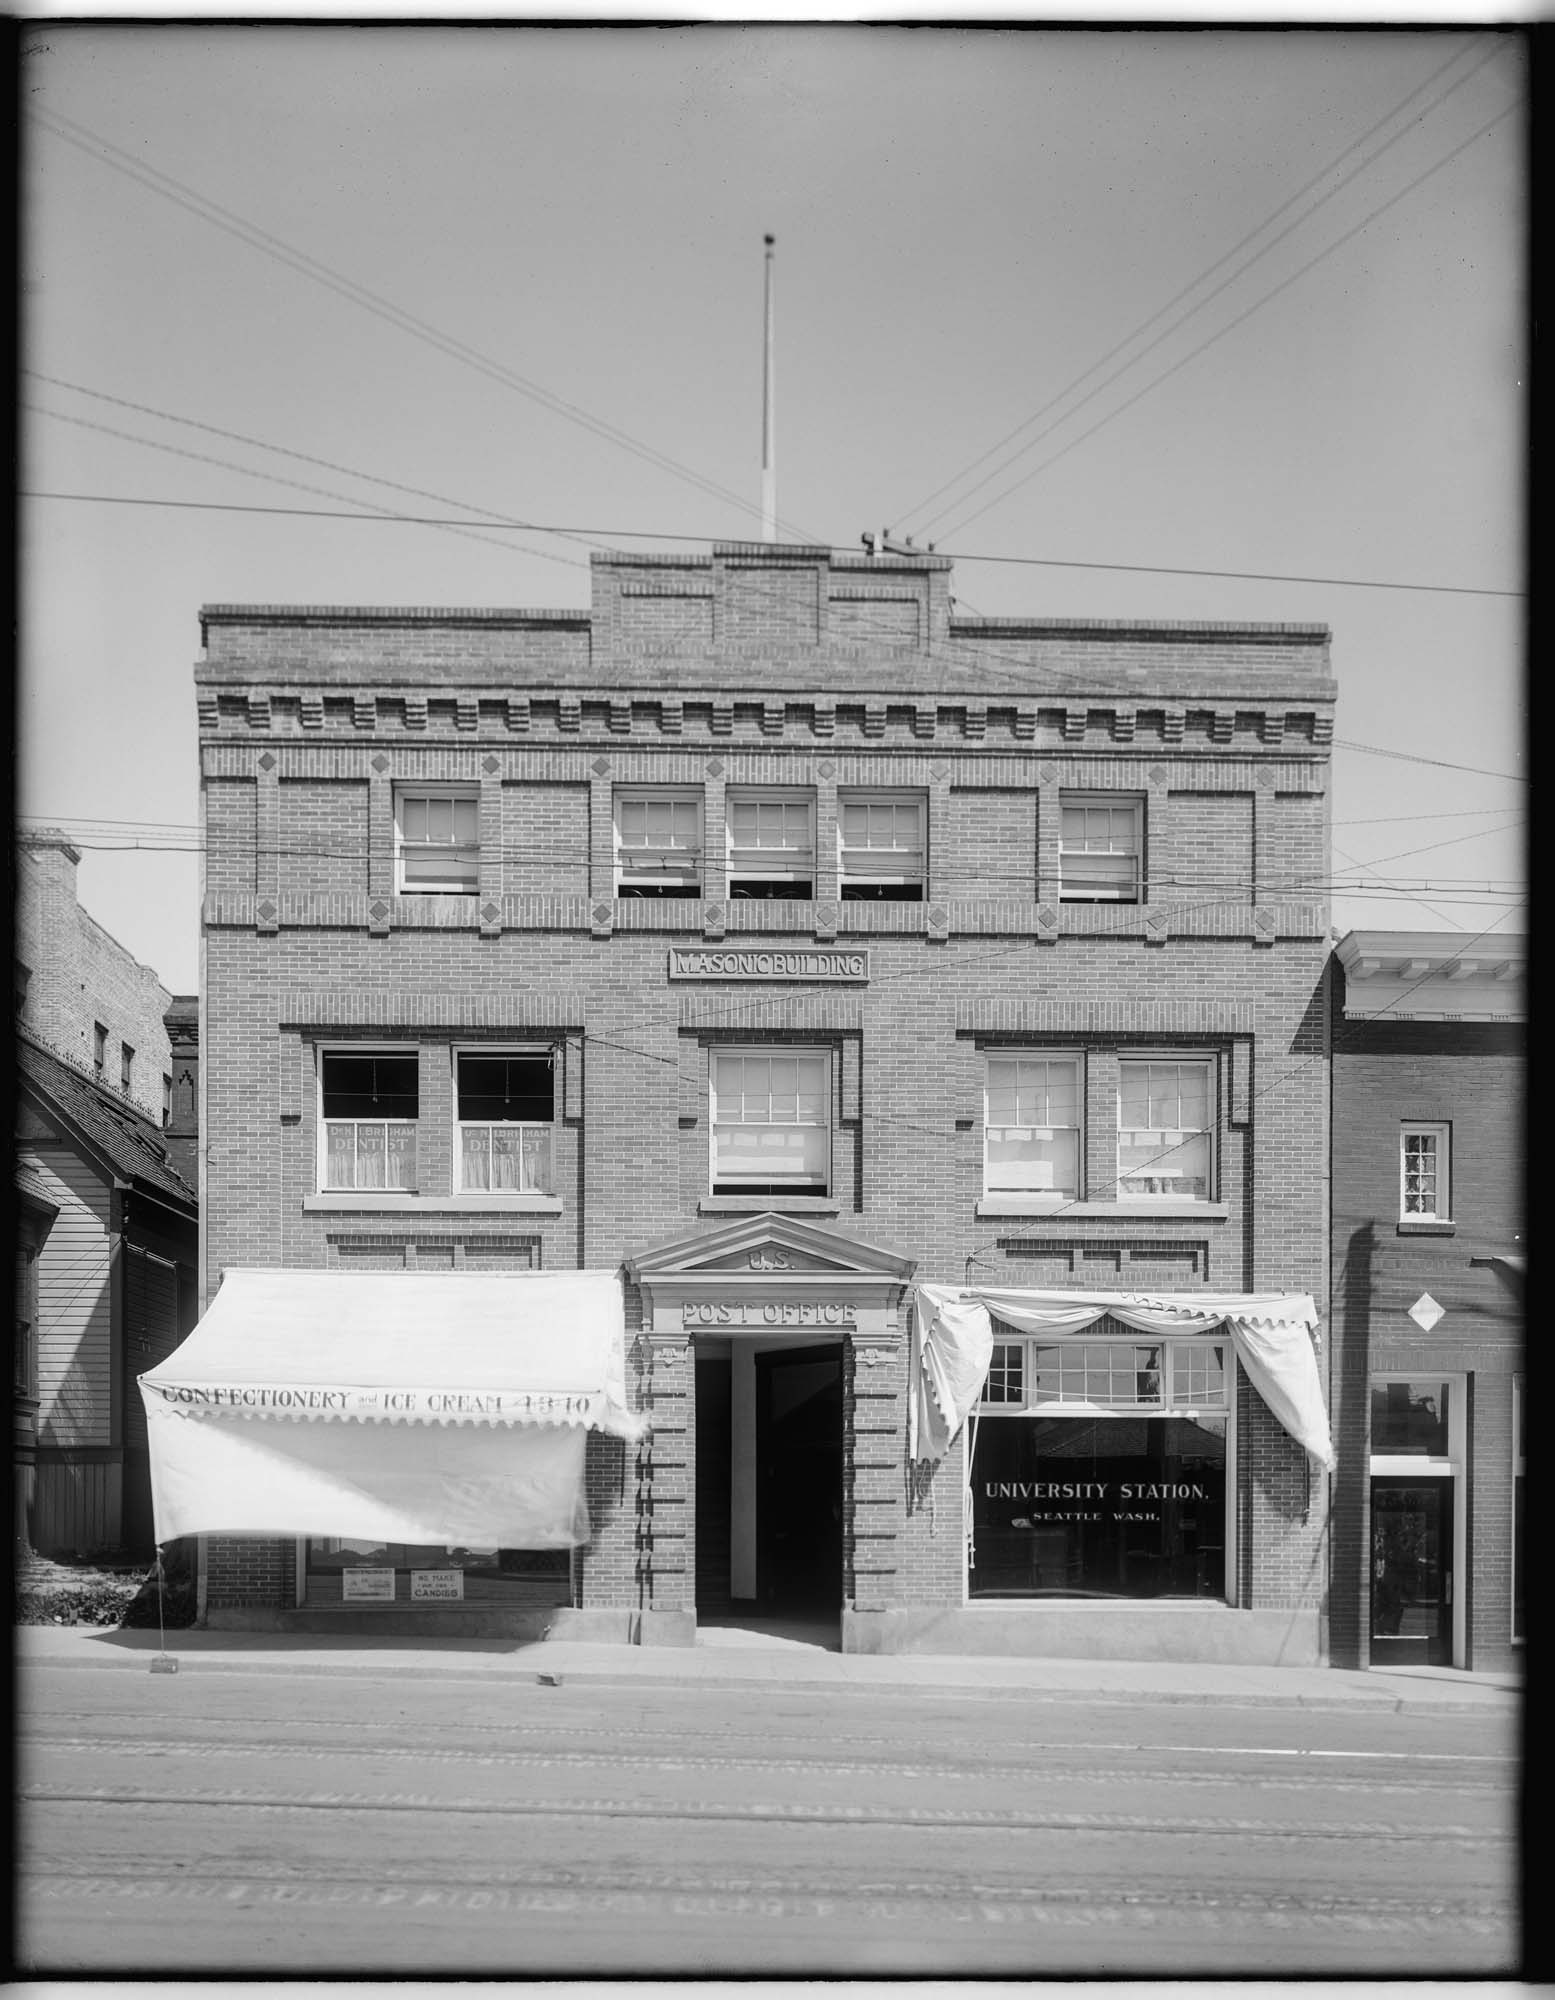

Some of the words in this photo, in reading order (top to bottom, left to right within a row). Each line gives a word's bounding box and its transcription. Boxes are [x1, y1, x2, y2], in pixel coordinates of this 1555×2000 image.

[676, 953, 769, 975] MASONIC
[771, 954, 865, 976] BUILDING
[335, 1138, 409, 1151] DENTIST
[470, 1139, 544, 1152] DENTIST
[748, 1250, 796, 1271] U.S.
[682, 1302, 755, 1324] POST
[762, 1303, 858, 1324] OFFICE
[162, 1386, 350, 1409] CONFECTIONERY
[384, 1393, 416, 1411] ICE
[427, 1394, 504, 1414] CREAM
[986, 1482, 1109, 1499] UNIVERSITY
[1120, 1483, 1209, 1499] STATION.
[1033, 1512, 1102, 1521] SEATTLE
[1113, 1512, 1160, 1521] WASH.
